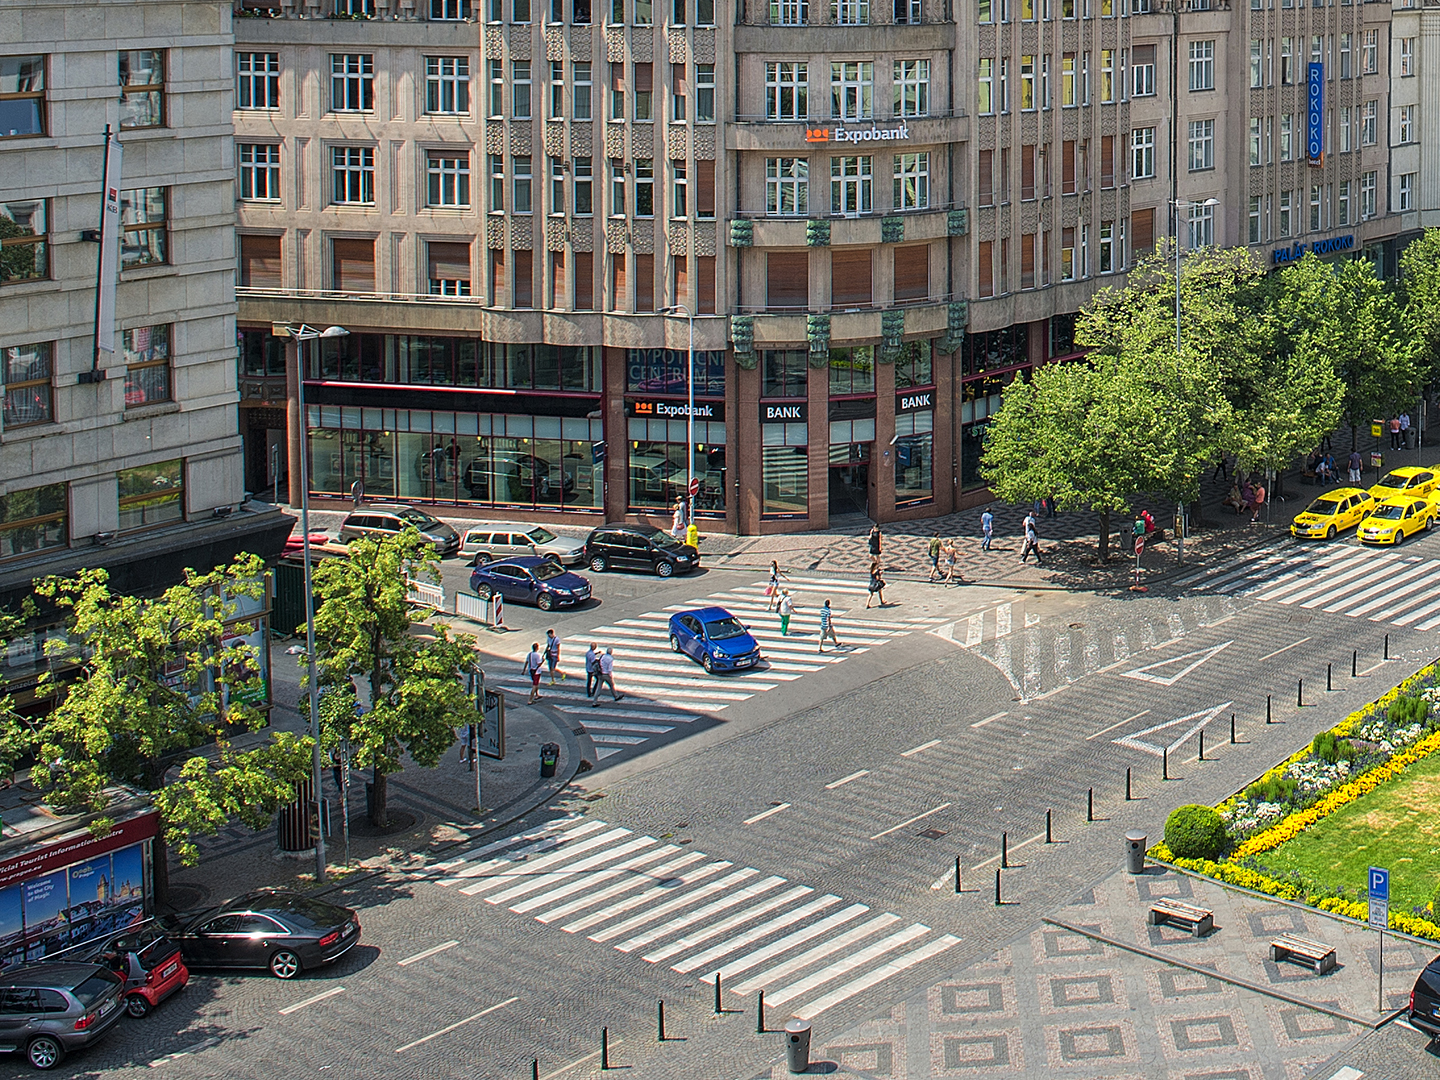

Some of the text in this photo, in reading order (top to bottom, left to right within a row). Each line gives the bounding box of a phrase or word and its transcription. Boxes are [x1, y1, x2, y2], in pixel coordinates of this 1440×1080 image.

[1310, 68, 1320, 155] ROKOKO
[834, 125, 909, 145] Expobank
[1312, 234, 1354, 255] ROKOKO
[656, 403, 714, 418] Expobank
[901, 394, 931, 410] BANK
[766, 406, 802, 419] BANK
[20, 853, 48, 867] Tourist
[49, 839, 98, 858] Information
[1372, 872, 1385, 889] P
